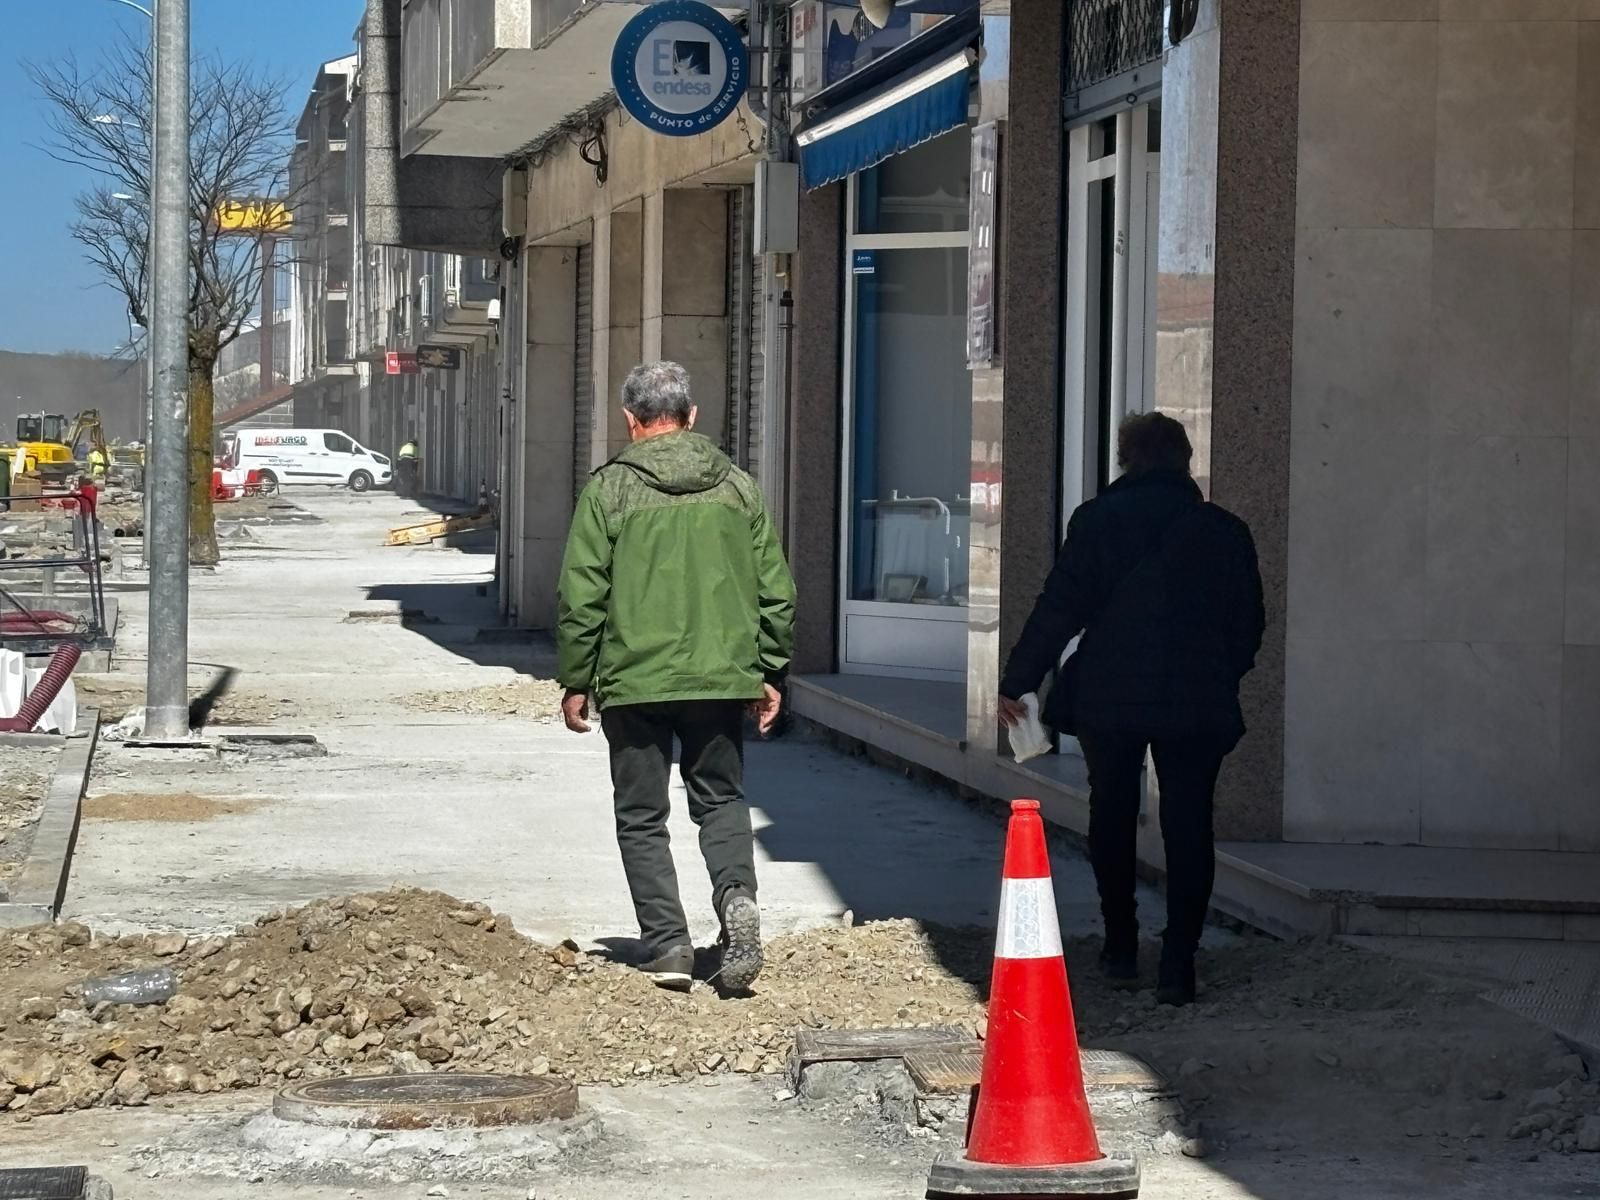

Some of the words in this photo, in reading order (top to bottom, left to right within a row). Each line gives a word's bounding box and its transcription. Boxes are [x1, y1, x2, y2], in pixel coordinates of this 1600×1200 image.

[650, 111, 694, 128] PUNTO
[698, 113, 712, 125] de
[713, 56, 740, 115] SERVICIO
[653, 79, 711, 95] endesa
